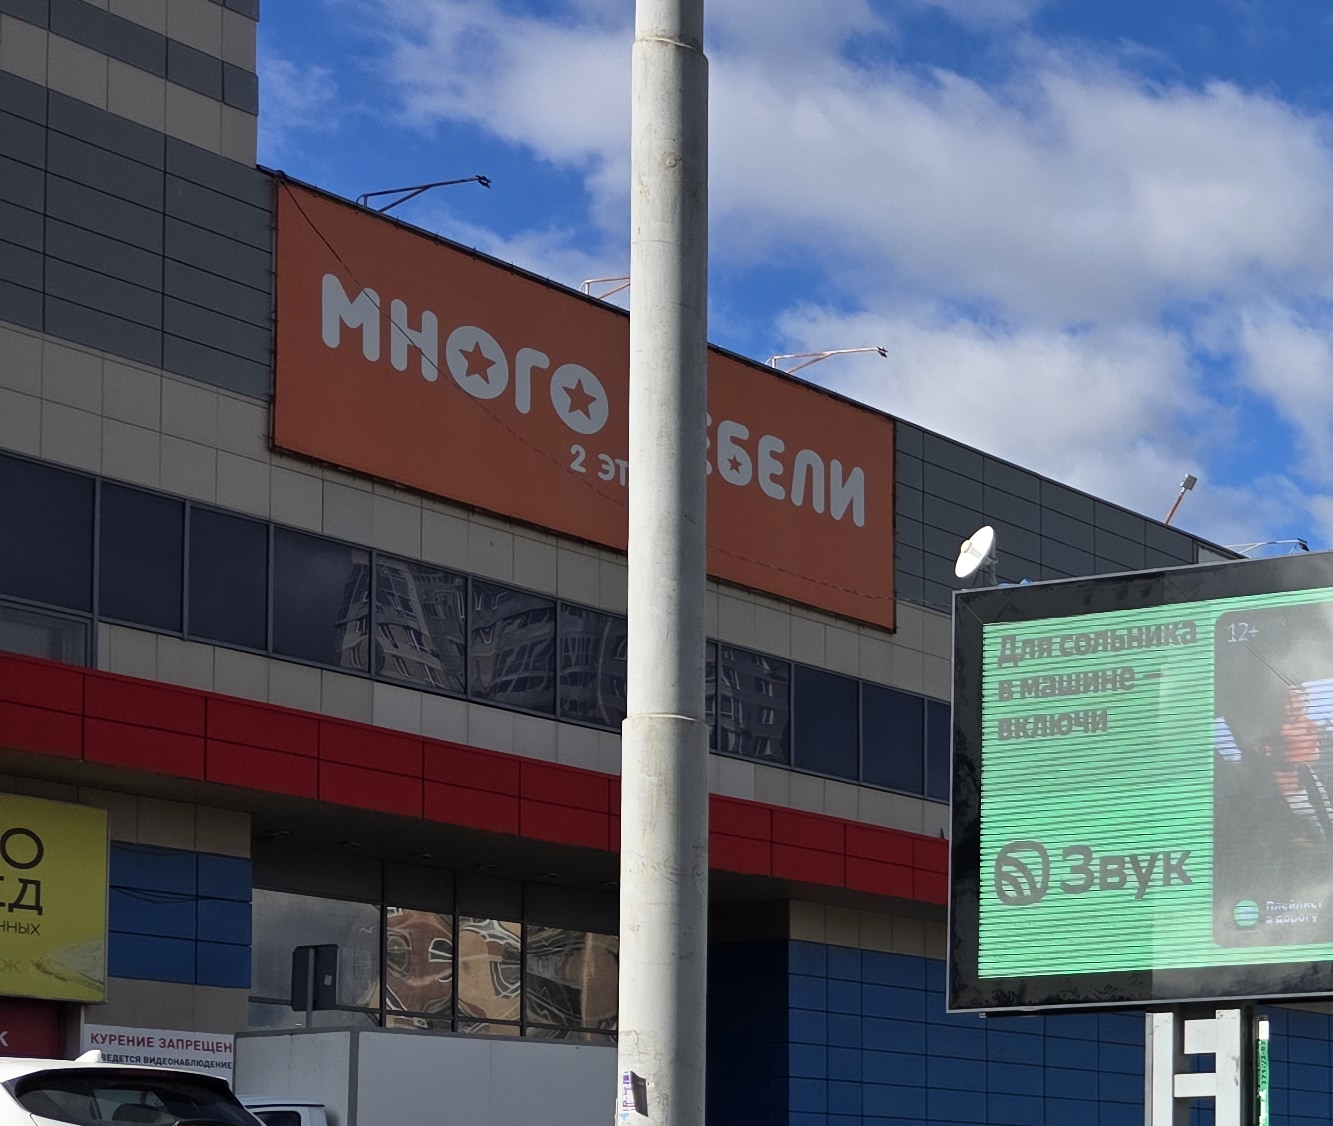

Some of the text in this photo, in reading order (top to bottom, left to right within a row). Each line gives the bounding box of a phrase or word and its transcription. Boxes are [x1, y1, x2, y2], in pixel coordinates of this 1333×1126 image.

[322, 273, 865, 528] МНОГО БЕЛИ
[570, 444, 629, 486] 2 ЭТ
[998, 620, 1197, 668] Для сольника
[998, 679, 1014, 700] в
[1019, 666, 1136, 700] машине
[998, 708, 1108, 741] включи
[1060, 845, 1194, 899] Звук
[91, 1033, 155, 1048] КУРЕНИЕ
[101, 1053, 232, 1070] ВЕДЕТСЯ ВИДЕОНАБЛЮДЕНИЕ
